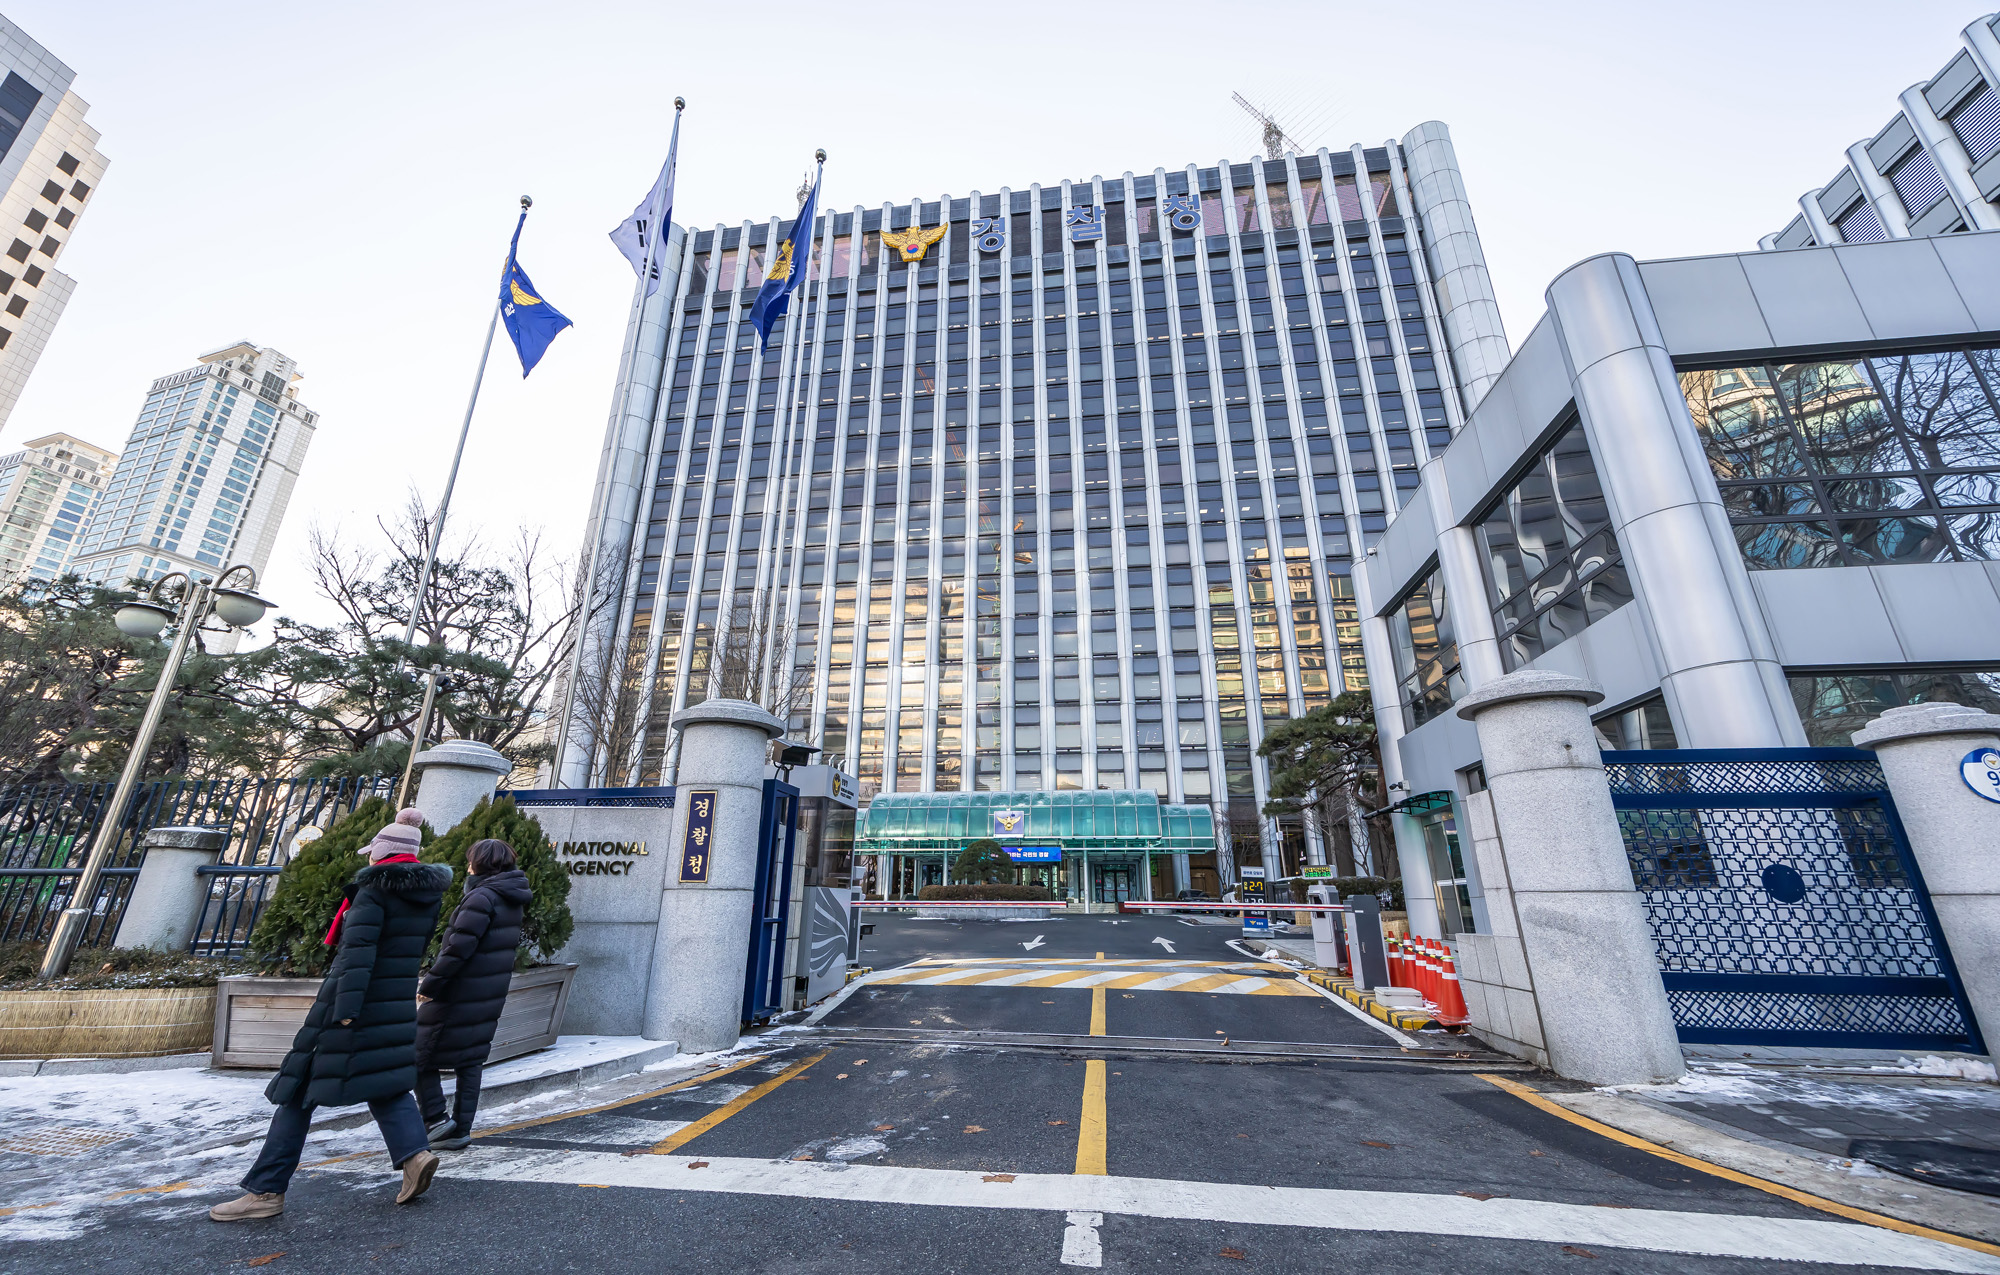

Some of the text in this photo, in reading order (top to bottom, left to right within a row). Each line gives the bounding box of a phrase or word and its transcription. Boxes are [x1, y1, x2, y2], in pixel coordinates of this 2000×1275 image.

[971, 194, 1202, 253] 경찰청
[562, 841, 649, 856] NATIONAL
[687, 798, 709, 875] 경찰청
[565, 861, 634, 876] AGENCY
